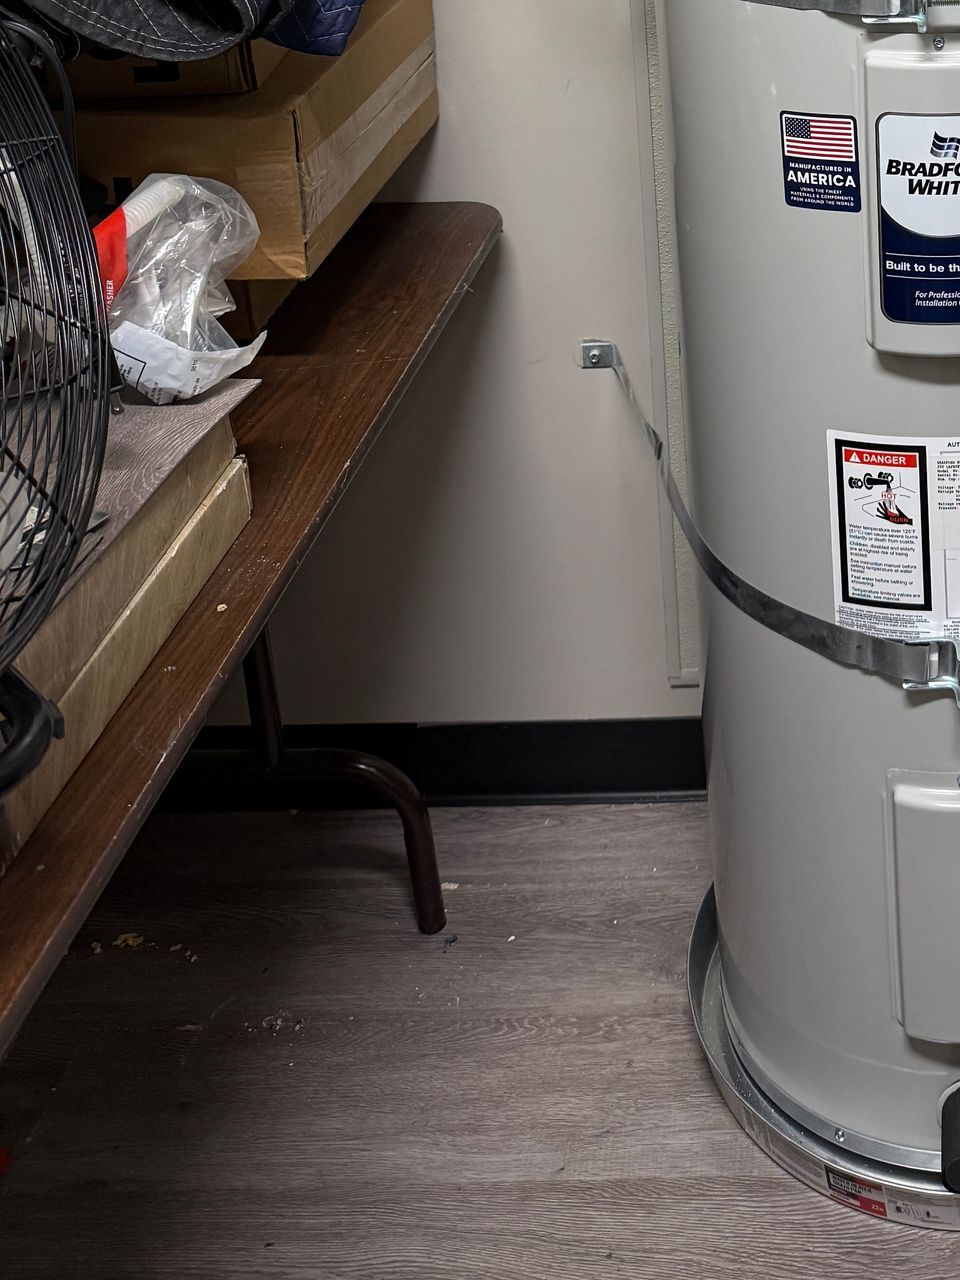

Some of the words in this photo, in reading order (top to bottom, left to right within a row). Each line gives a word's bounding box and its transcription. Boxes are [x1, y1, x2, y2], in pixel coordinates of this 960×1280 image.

[790, 162, 842, 172] MANUFACTURED
[787, 170, 856, 187] AMERICA
[886, 260, 910, 271] Built
[914, 263, 926, 272] to
[930, 263, 945, 273] be
[915, 298, 957, 307] Installation
[863, 454, 906, 464] DANGER
